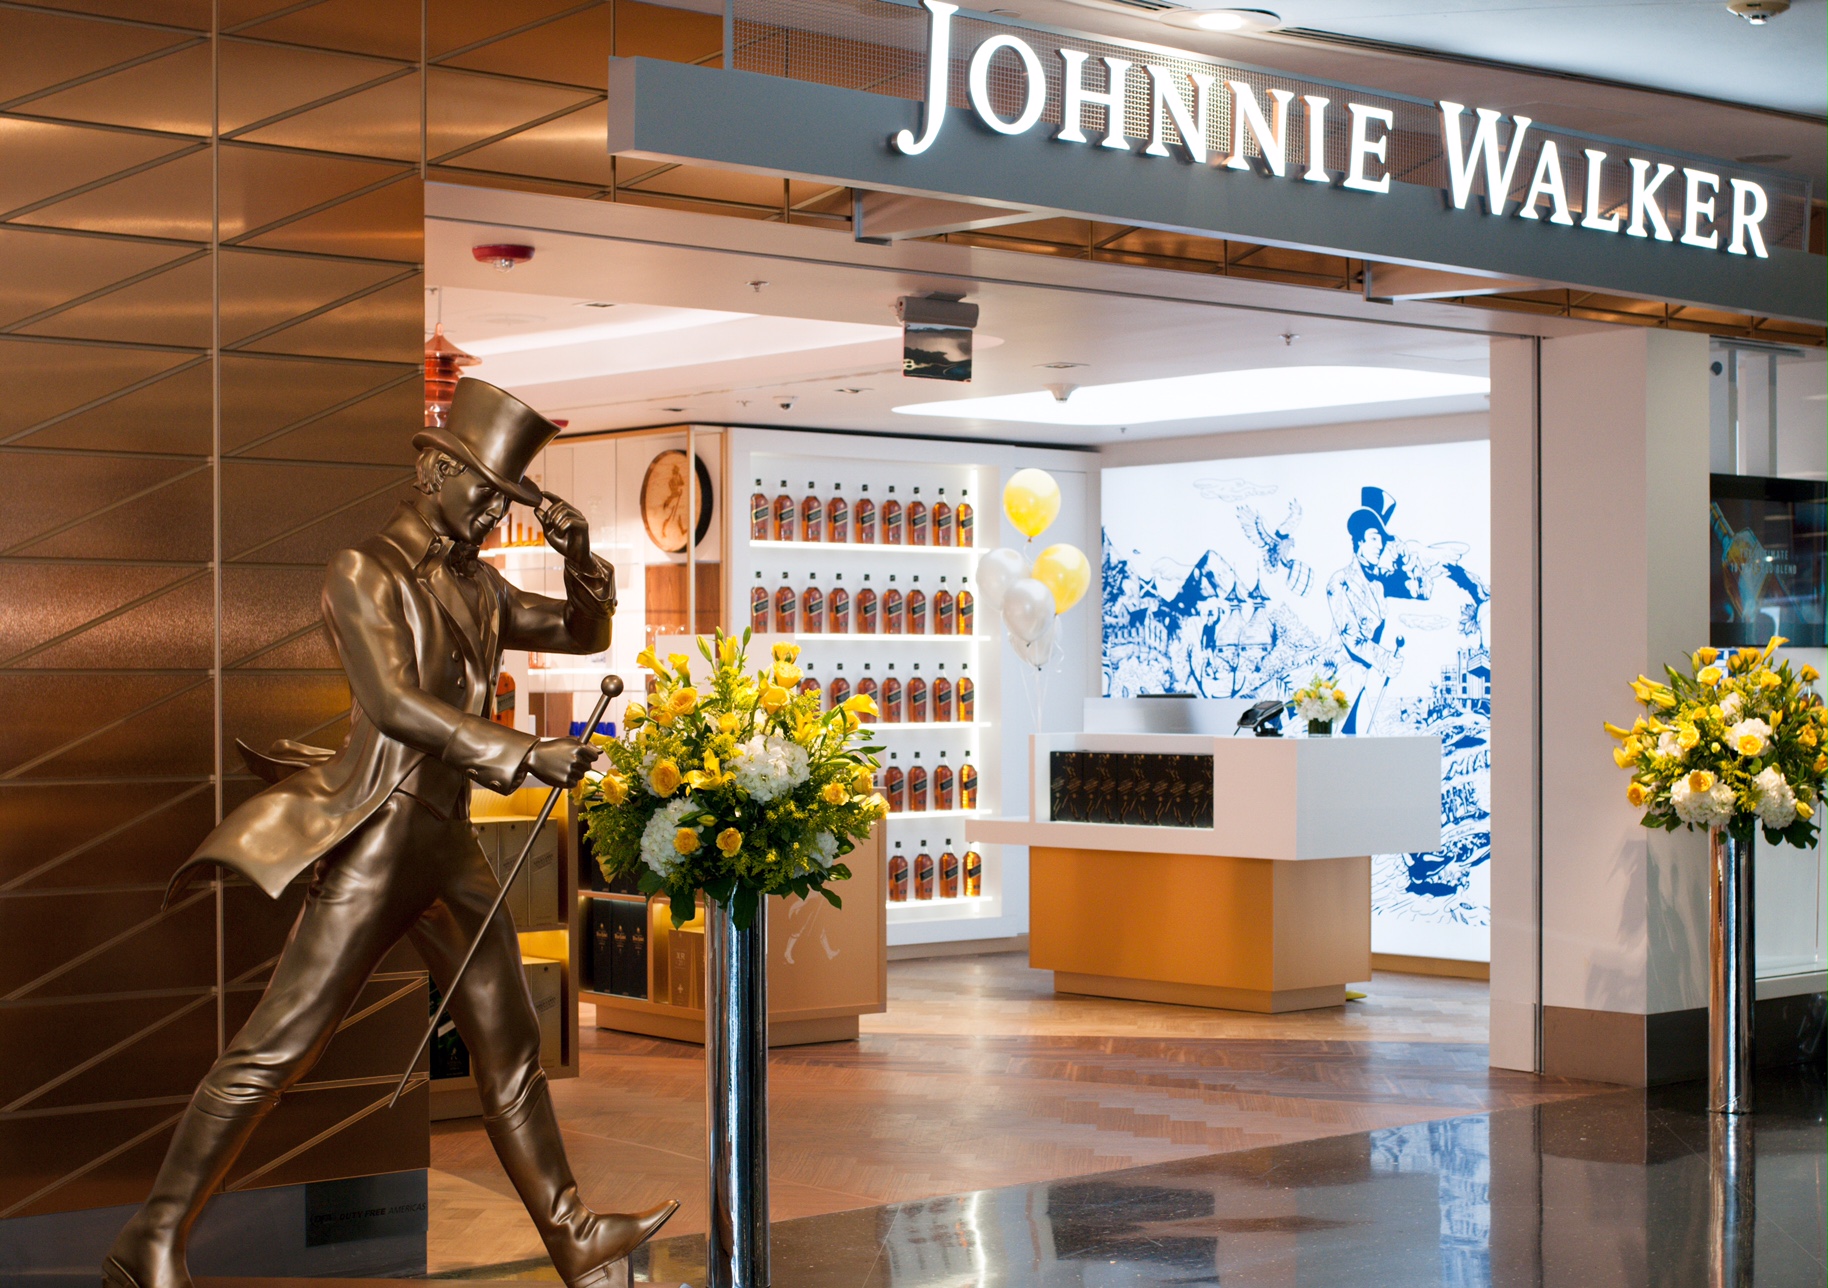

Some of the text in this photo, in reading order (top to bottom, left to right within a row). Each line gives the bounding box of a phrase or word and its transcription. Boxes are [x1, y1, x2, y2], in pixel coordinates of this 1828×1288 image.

[897, 0, 1769, 259] JOHNNIE WALKER
[1776, 564, 1797, 575] BLEND
[339, 1211, 363, 1221] DUTY
[364, 1207, 386, 1218] FREE
[388, 1202, 426, 1215] AMERICAS
